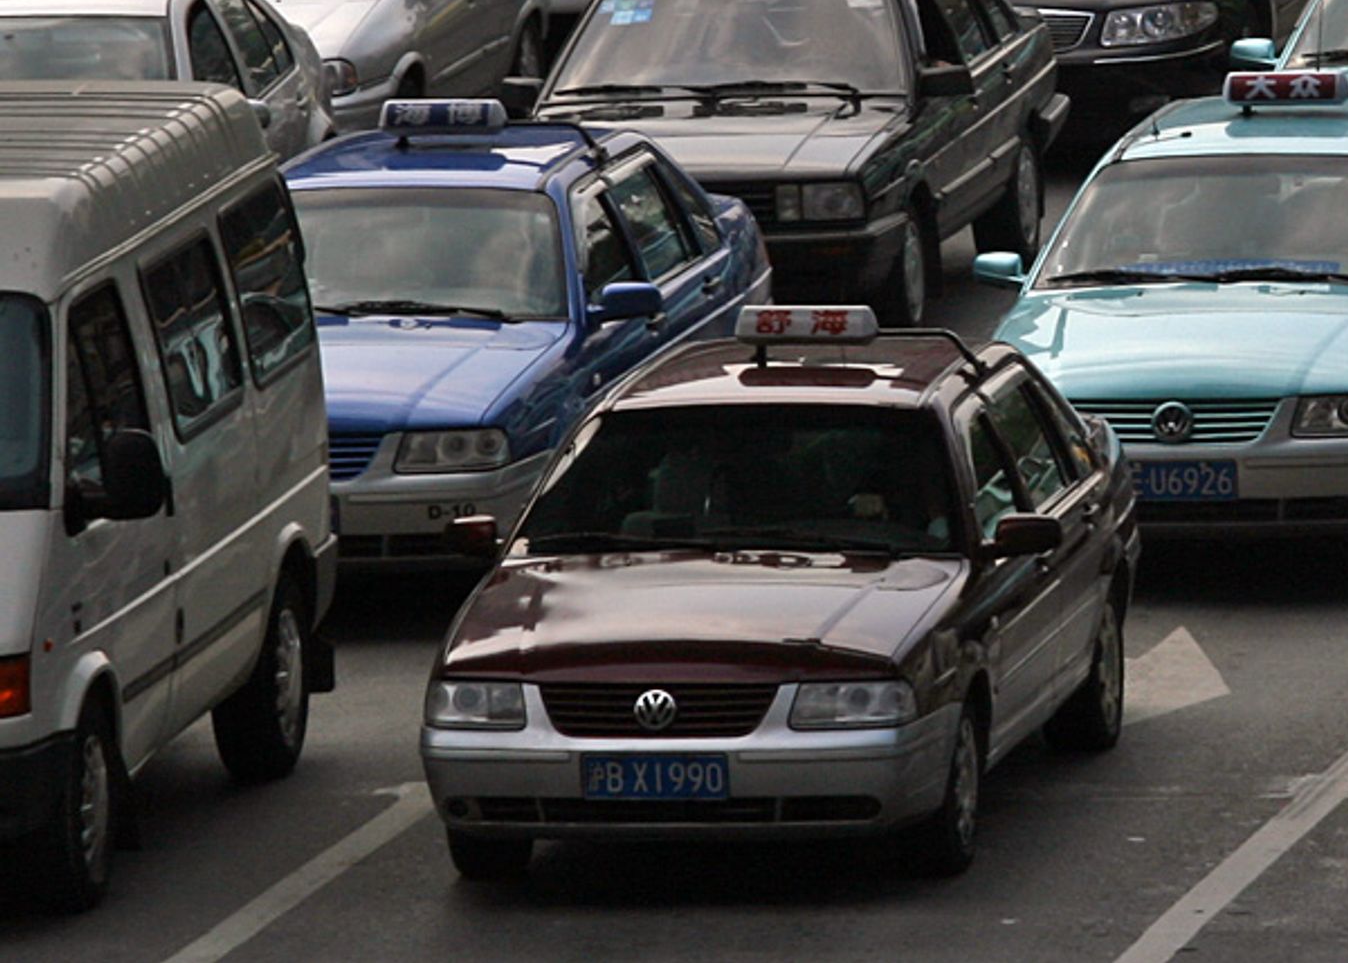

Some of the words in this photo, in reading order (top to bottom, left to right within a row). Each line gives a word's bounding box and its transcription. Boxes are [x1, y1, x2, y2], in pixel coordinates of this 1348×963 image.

[1245, 74, 1321, 99] 大众
[394, 103, 482, 125] 海博
[756, 309, 849, 335] 舒海
